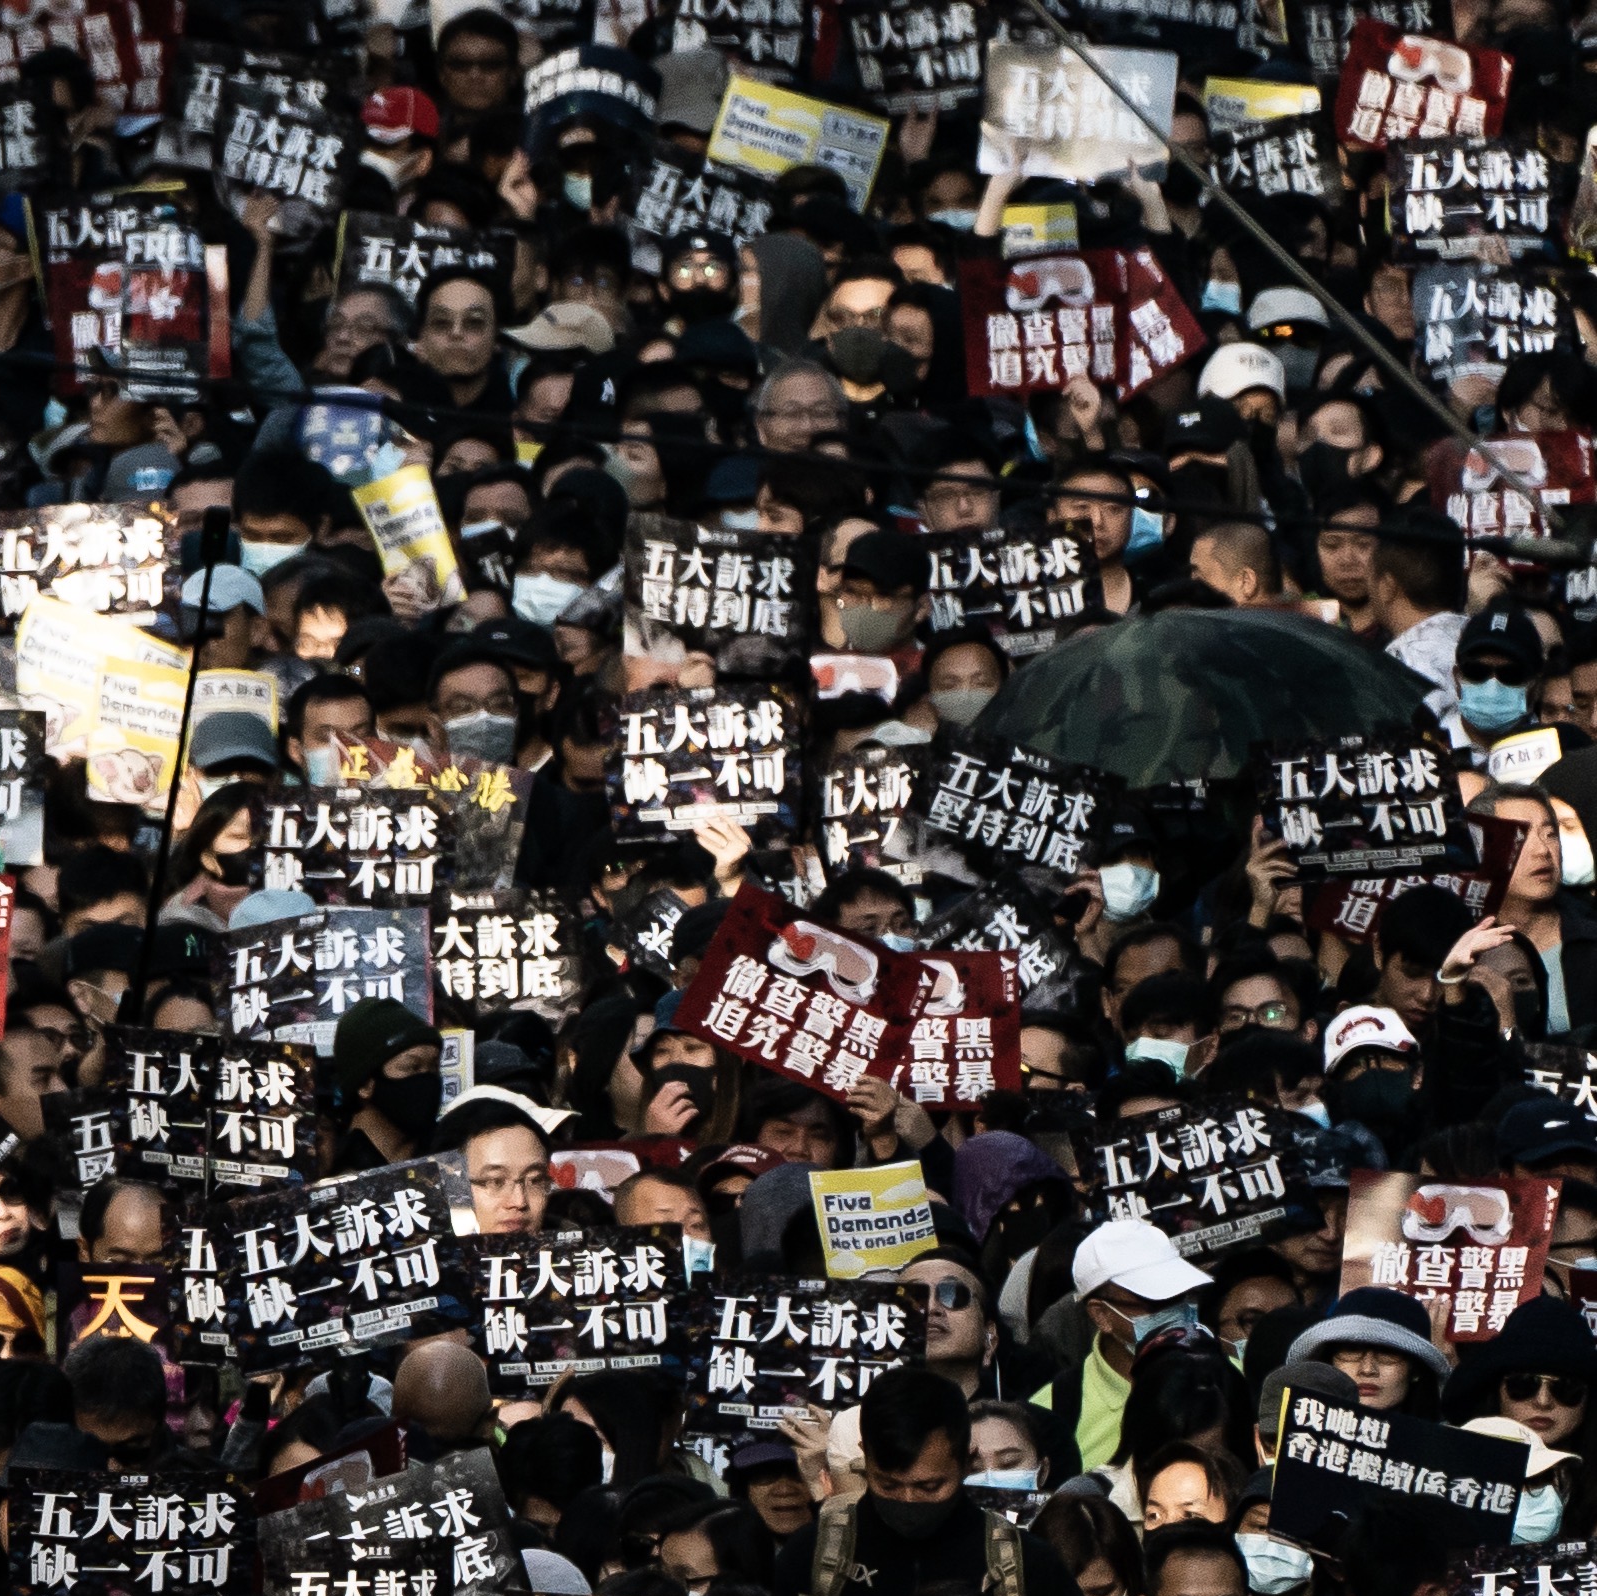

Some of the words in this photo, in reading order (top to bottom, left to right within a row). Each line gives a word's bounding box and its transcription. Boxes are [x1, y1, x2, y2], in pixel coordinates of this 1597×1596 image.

[642, 545, 797, 592] 五大訴求
[929, 540, 1082, 590] 五大訴求
[927, 585, 1085, 633] 缺一不可
[619, 700, 784, 755] 五大訴求
[624, 750, 785, 803] 缺一不可
[947, 752, 1097, 830] 五大訴求
[1272, 750, 1439, 800] 五大訴求
[264, 803, 439, 850] 五大訴求
[925, 790, 1087, 873] 堅持到底
[1280, 800, 1447, 845] 缺一不可
[264, 853, 439, 897] 缺一不可
[230, 925, 404, 985] 五大訴求
[230, 975, 404, 1035] 缺一不可
[722, 955, 887, 1060] 徹查警黑
[702, 1000, 867, 1085] 追究警暴
[127, 1050, 297, 1105] 五大訴求
[127, 1100, 297, 1157] 缺一不可
[824, 1195, 871, 1210] Five
[235, 1190, 432, 1278] 五大訴求
[247, 1240, 440, 1330] 缺一不可
[482, 1247, 667, 1300] 五大訴求
[485, 1302, 669, 1352] 缺一不可
[710, 1297, 907, 1350] 五大訴求
[1294, 1397, 1390, 1450] 我哋想
[1287, 1432, 1517, 1515] 香港繼續係香港
[32, 1493, 237, 1540] 五大訴求
[32, 1545, 237, 1592] 缺一不可
